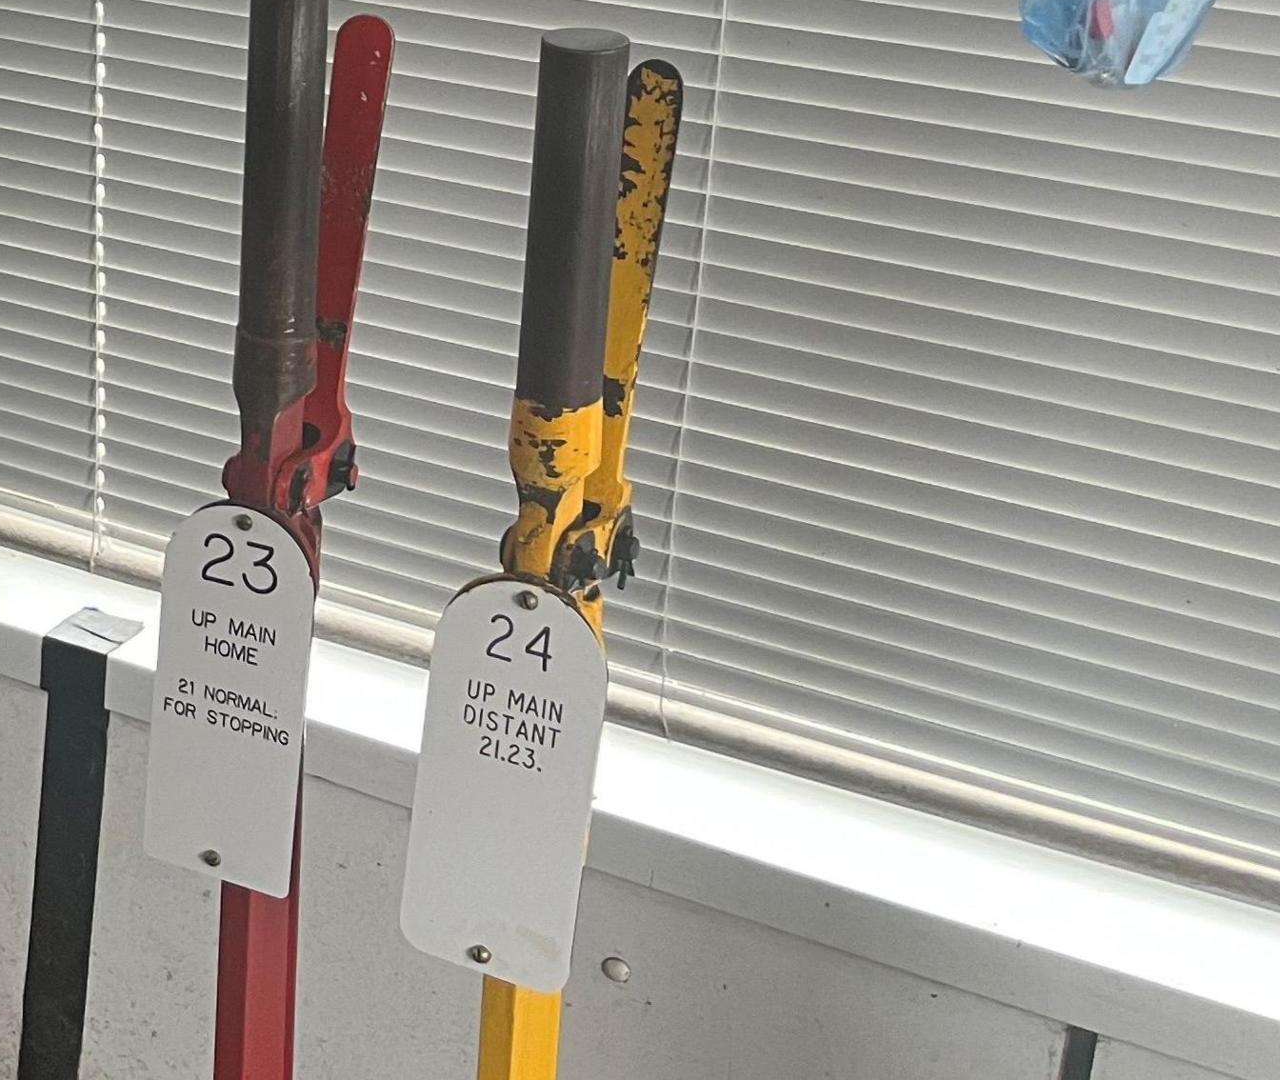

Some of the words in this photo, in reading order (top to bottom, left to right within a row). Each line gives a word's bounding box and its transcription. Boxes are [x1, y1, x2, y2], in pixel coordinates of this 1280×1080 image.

[201, 533, 278, 595] 23
[191, 608, 217, 629] UP
[228, 618, 276, 646] MAIN
[486, 614, 553, 672] 24
[204, 635, 258, 667] HOME
[178, 678, 195, 695] 21
[467, 679, 496, 703] UP
[507, 689, 563, 724] MAIN
[163, 697, 196, 720] FOR
[206, 709, 290, 746] STOPPING
[463, 703, 562, 749] DISTANT
[479, 735, 542, 772] 21.23.
